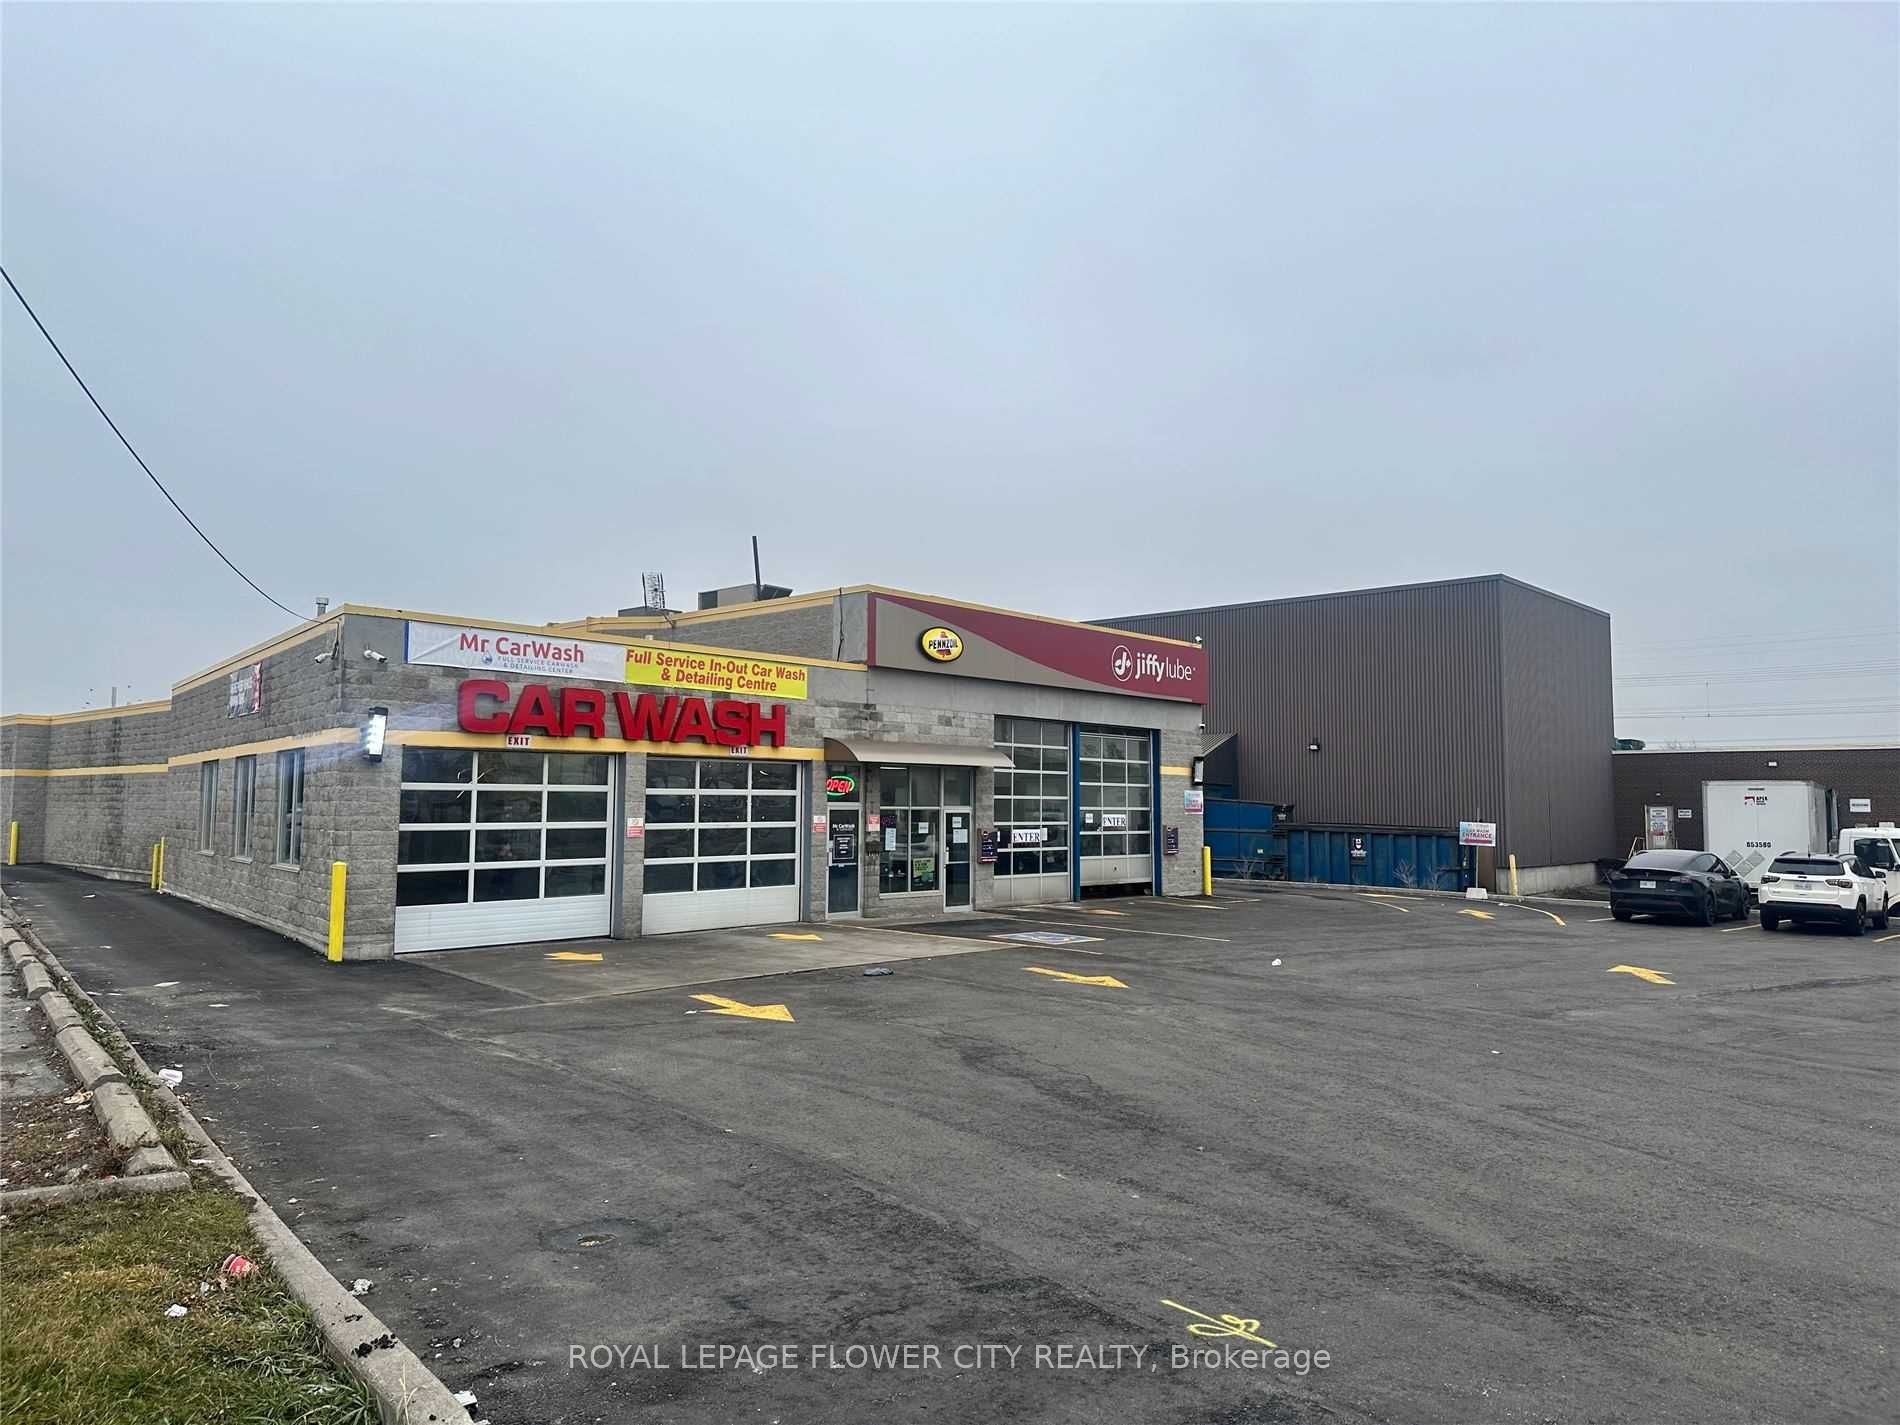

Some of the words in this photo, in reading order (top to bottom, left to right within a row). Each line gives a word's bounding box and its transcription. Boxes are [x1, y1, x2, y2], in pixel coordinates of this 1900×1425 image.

[459, 633, 490, 652] Mr
[495, 637, 584, 663] CarWash
[928, 639, 959, 650] PENNZOIL
[497, 655, 514, 663] FULL
[517, 657, 545, 666] SERVICE
[546, 660, 578, 669] CARWASH
[510, 663, 547, 672] DETAILING
[626, 649, 651, 664] Full
[656, 652, 705, 670] Service
[709, 659, 748, 675] In-Out
[751, 664, 772, 678] Car
[776, 666, 805, 681] Wash
[1135, 652, 1165, 682] jiffy
[1166, 656, 1192, 681] lube
[661, 667, 671, 681] &
[675, 669, 732, 689] Detailing
[737, 676, 777, 691] Centre
[457, 679, 606, 738] CAR
[612, 691, 786, 747] WASH
[507, 736, 530, 746] EXIT
[730, 745, 748, 755] EXIT
[826, 779, 851, 793] OPEN
[1103, 816, 1127, 827] ENTER
[1013, 832, 1040, 842] ENTER
